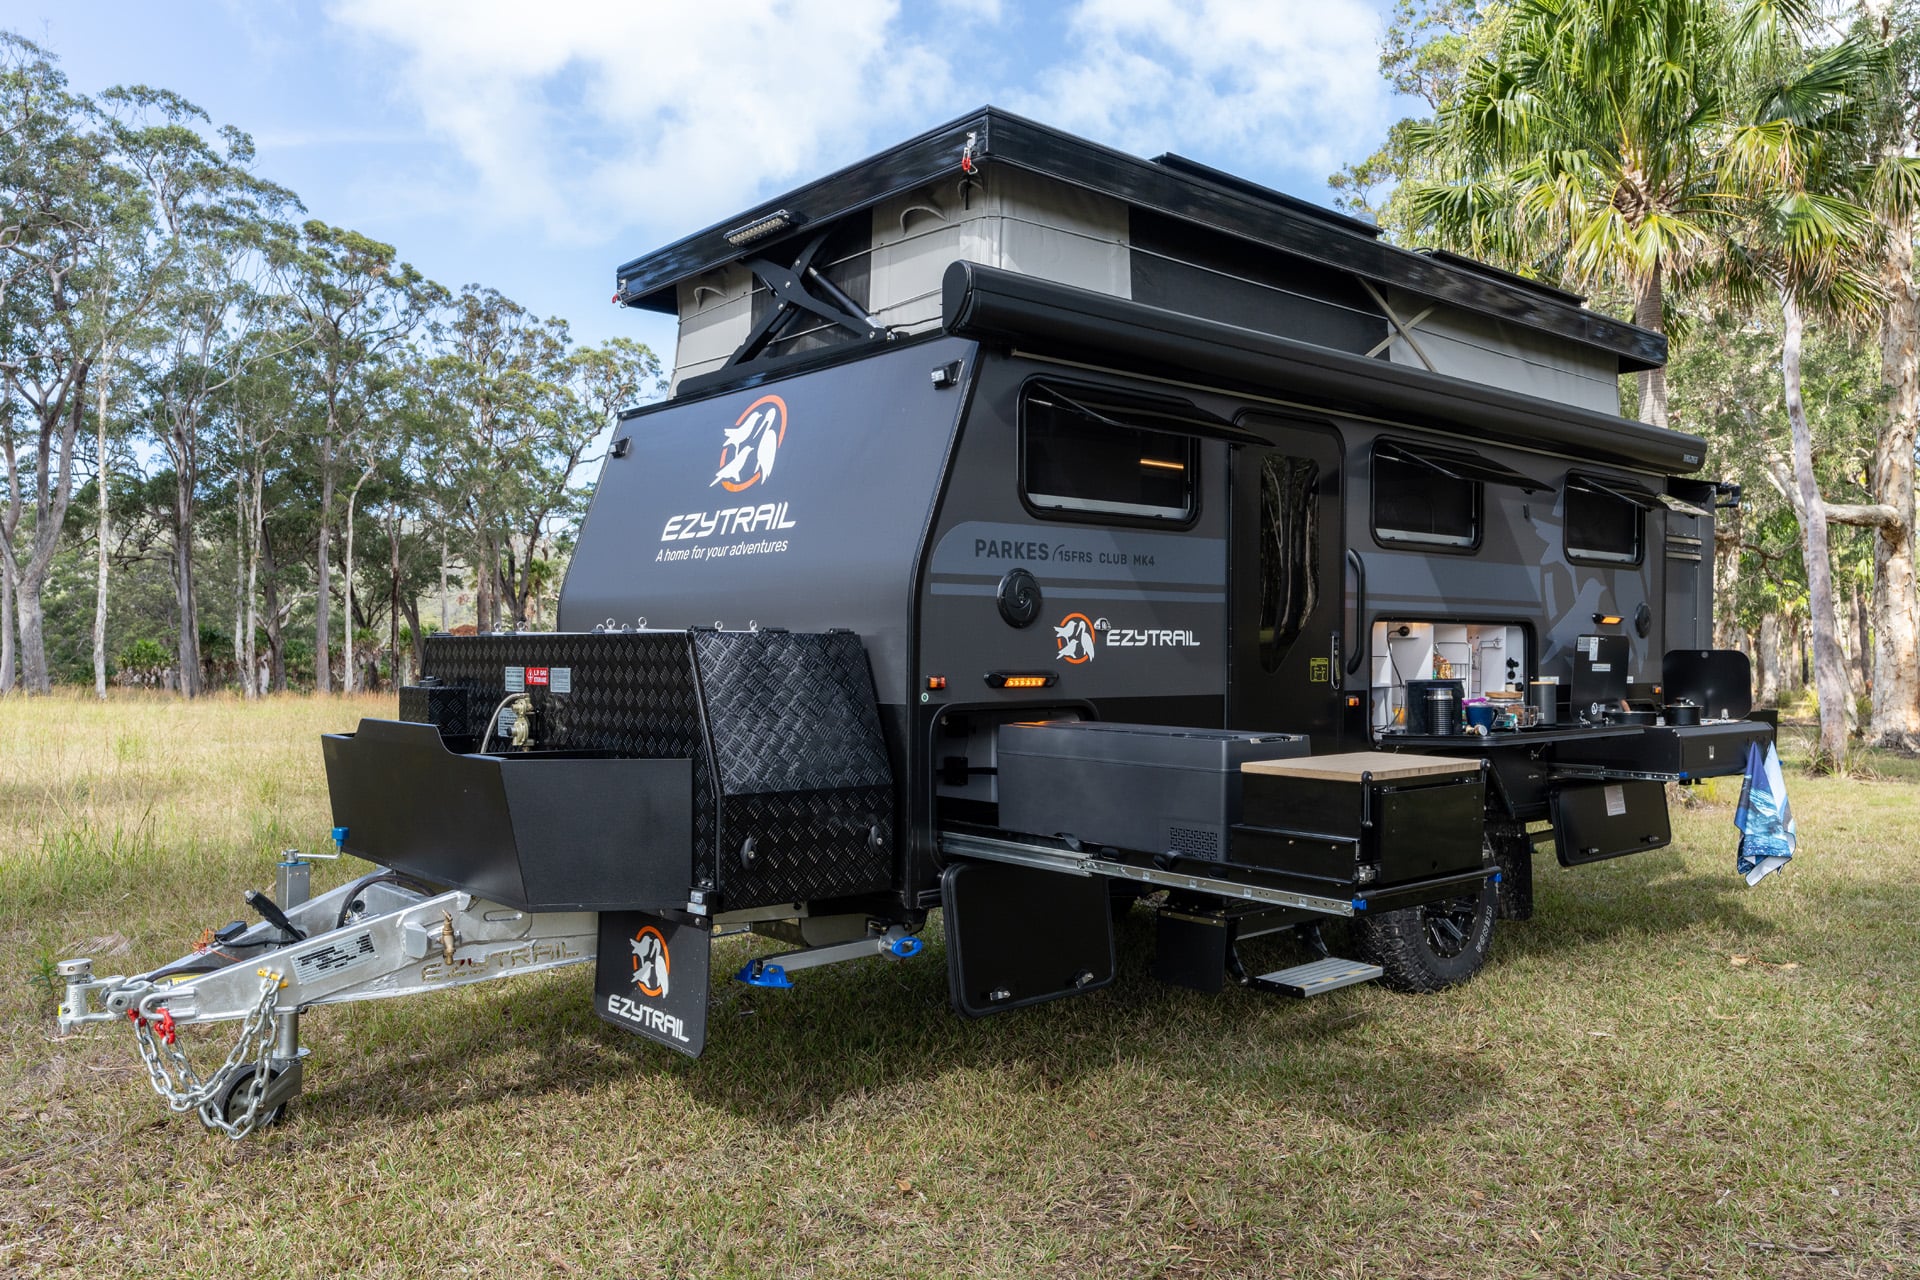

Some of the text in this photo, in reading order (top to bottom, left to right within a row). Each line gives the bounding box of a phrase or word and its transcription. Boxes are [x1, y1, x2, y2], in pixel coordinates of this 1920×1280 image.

[661, 501, 796, 541] EZYTRAIL
[655, 539, 789, 562] A home for your adventures
[975, 538, 1155, 567] PARKES 15FRS CLUB MK4
[1106, 629, 1200, 646] EZYTRAIL
[608, 994, 690, 1043] EZYTRAIL
